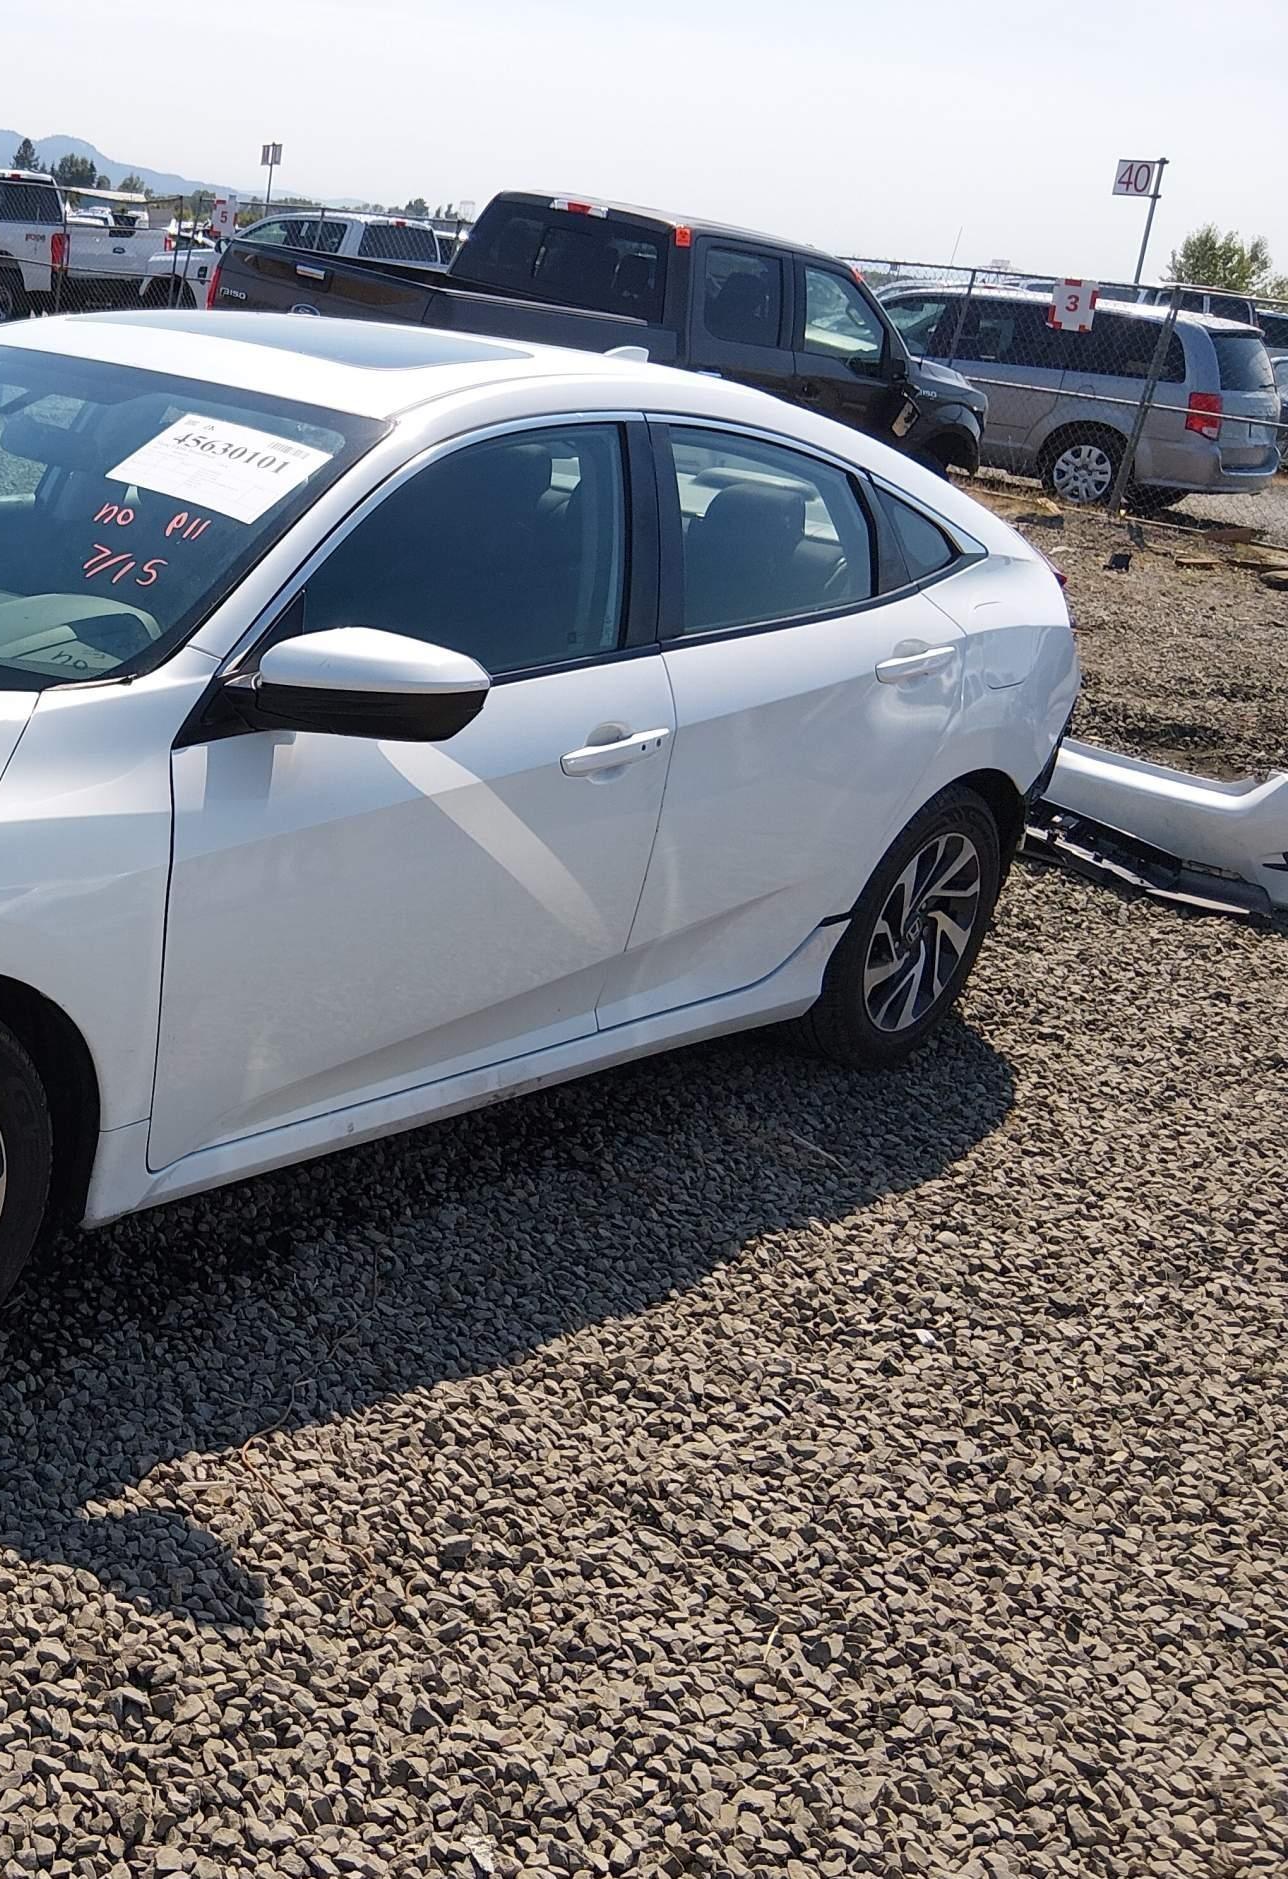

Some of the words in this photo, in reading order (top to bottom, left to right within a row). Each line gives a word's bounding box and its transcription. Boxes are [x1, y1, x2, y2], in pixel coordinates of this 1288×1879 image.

[1117, 162, 1151, 193] 40
[219, 210, 229, 224] 5
[1065, 294, 1080, 313] 3
[174, 432, 291, 474] 45630101
[93, 502, 136, 526] no
[82, 543, 169, 587] 7/15
